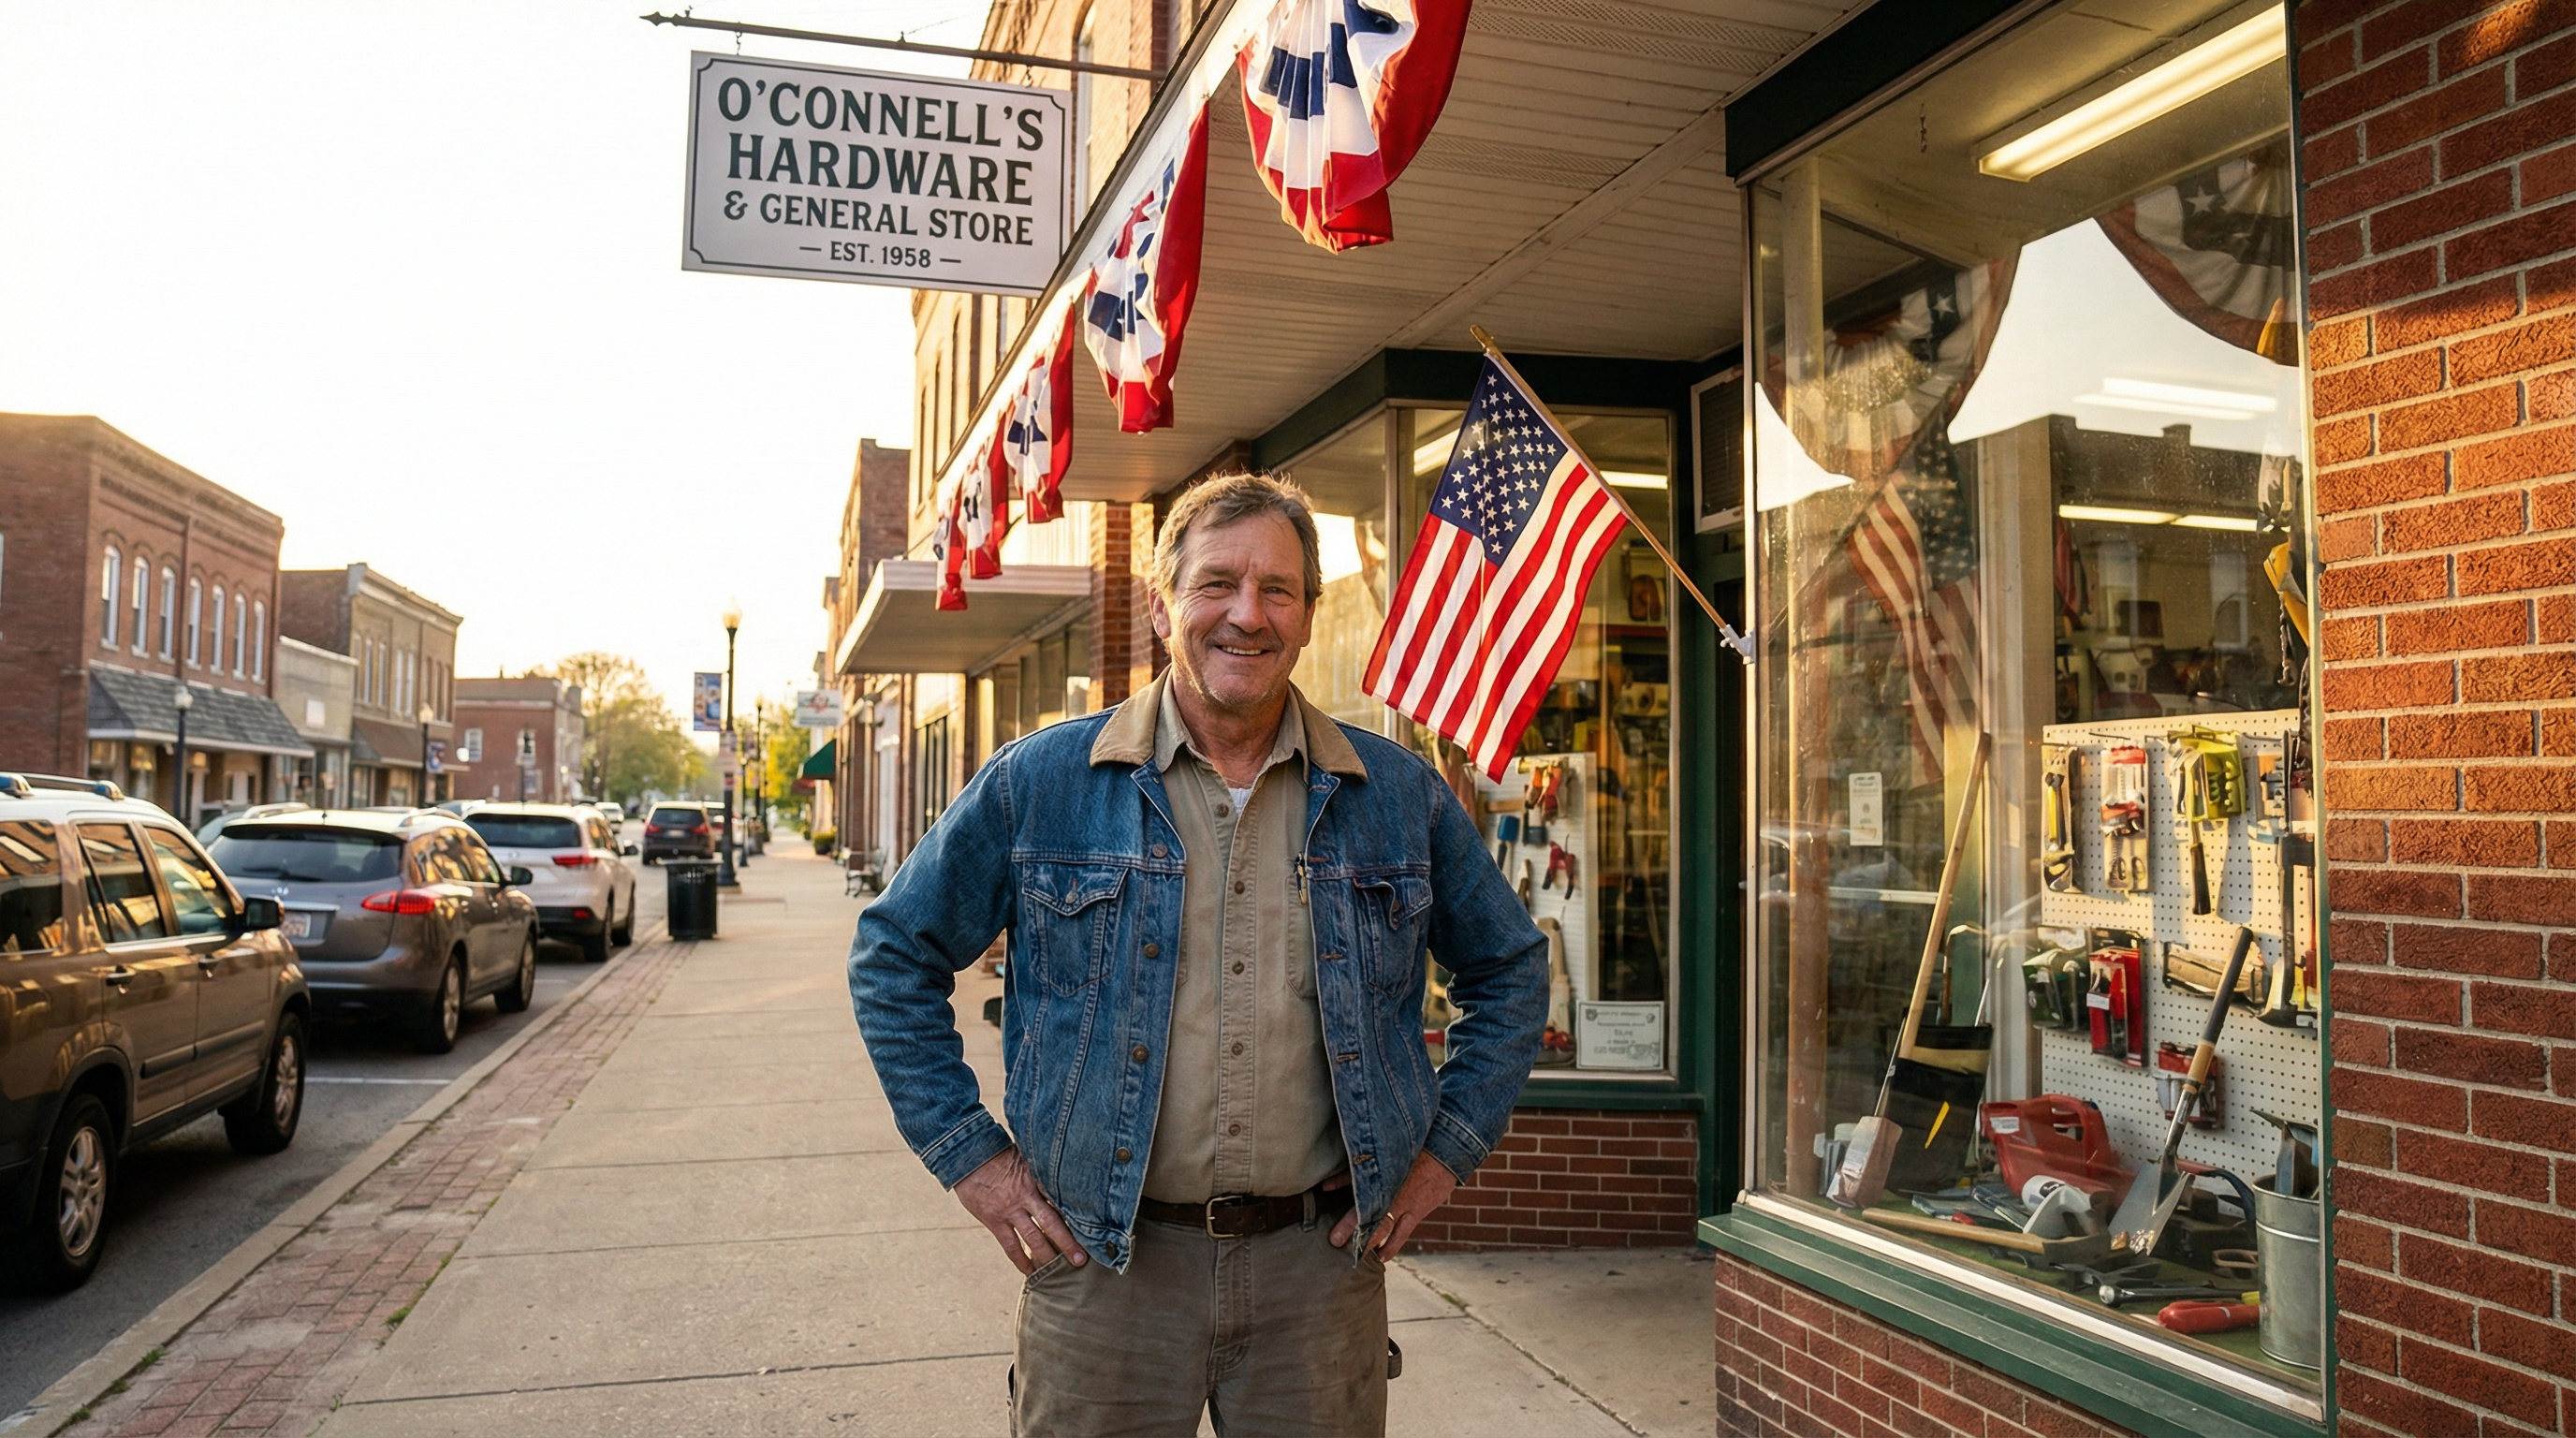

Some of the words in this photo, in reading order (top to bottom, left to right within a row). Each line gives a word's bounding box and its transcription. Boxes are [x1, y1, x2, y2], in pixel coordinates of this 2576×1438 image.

[717, 77, 1044, 152] O'CONNELL'S
[726, 132, 1033, 206] HARDWARE
[724, 190, 749, 221] &
[759, 193, 918, 236] GENERAL
[929, 208, 1033, 246] STORE
[830, 241, 874, 263] EST.
[882, 245, 931, 269] 1958
